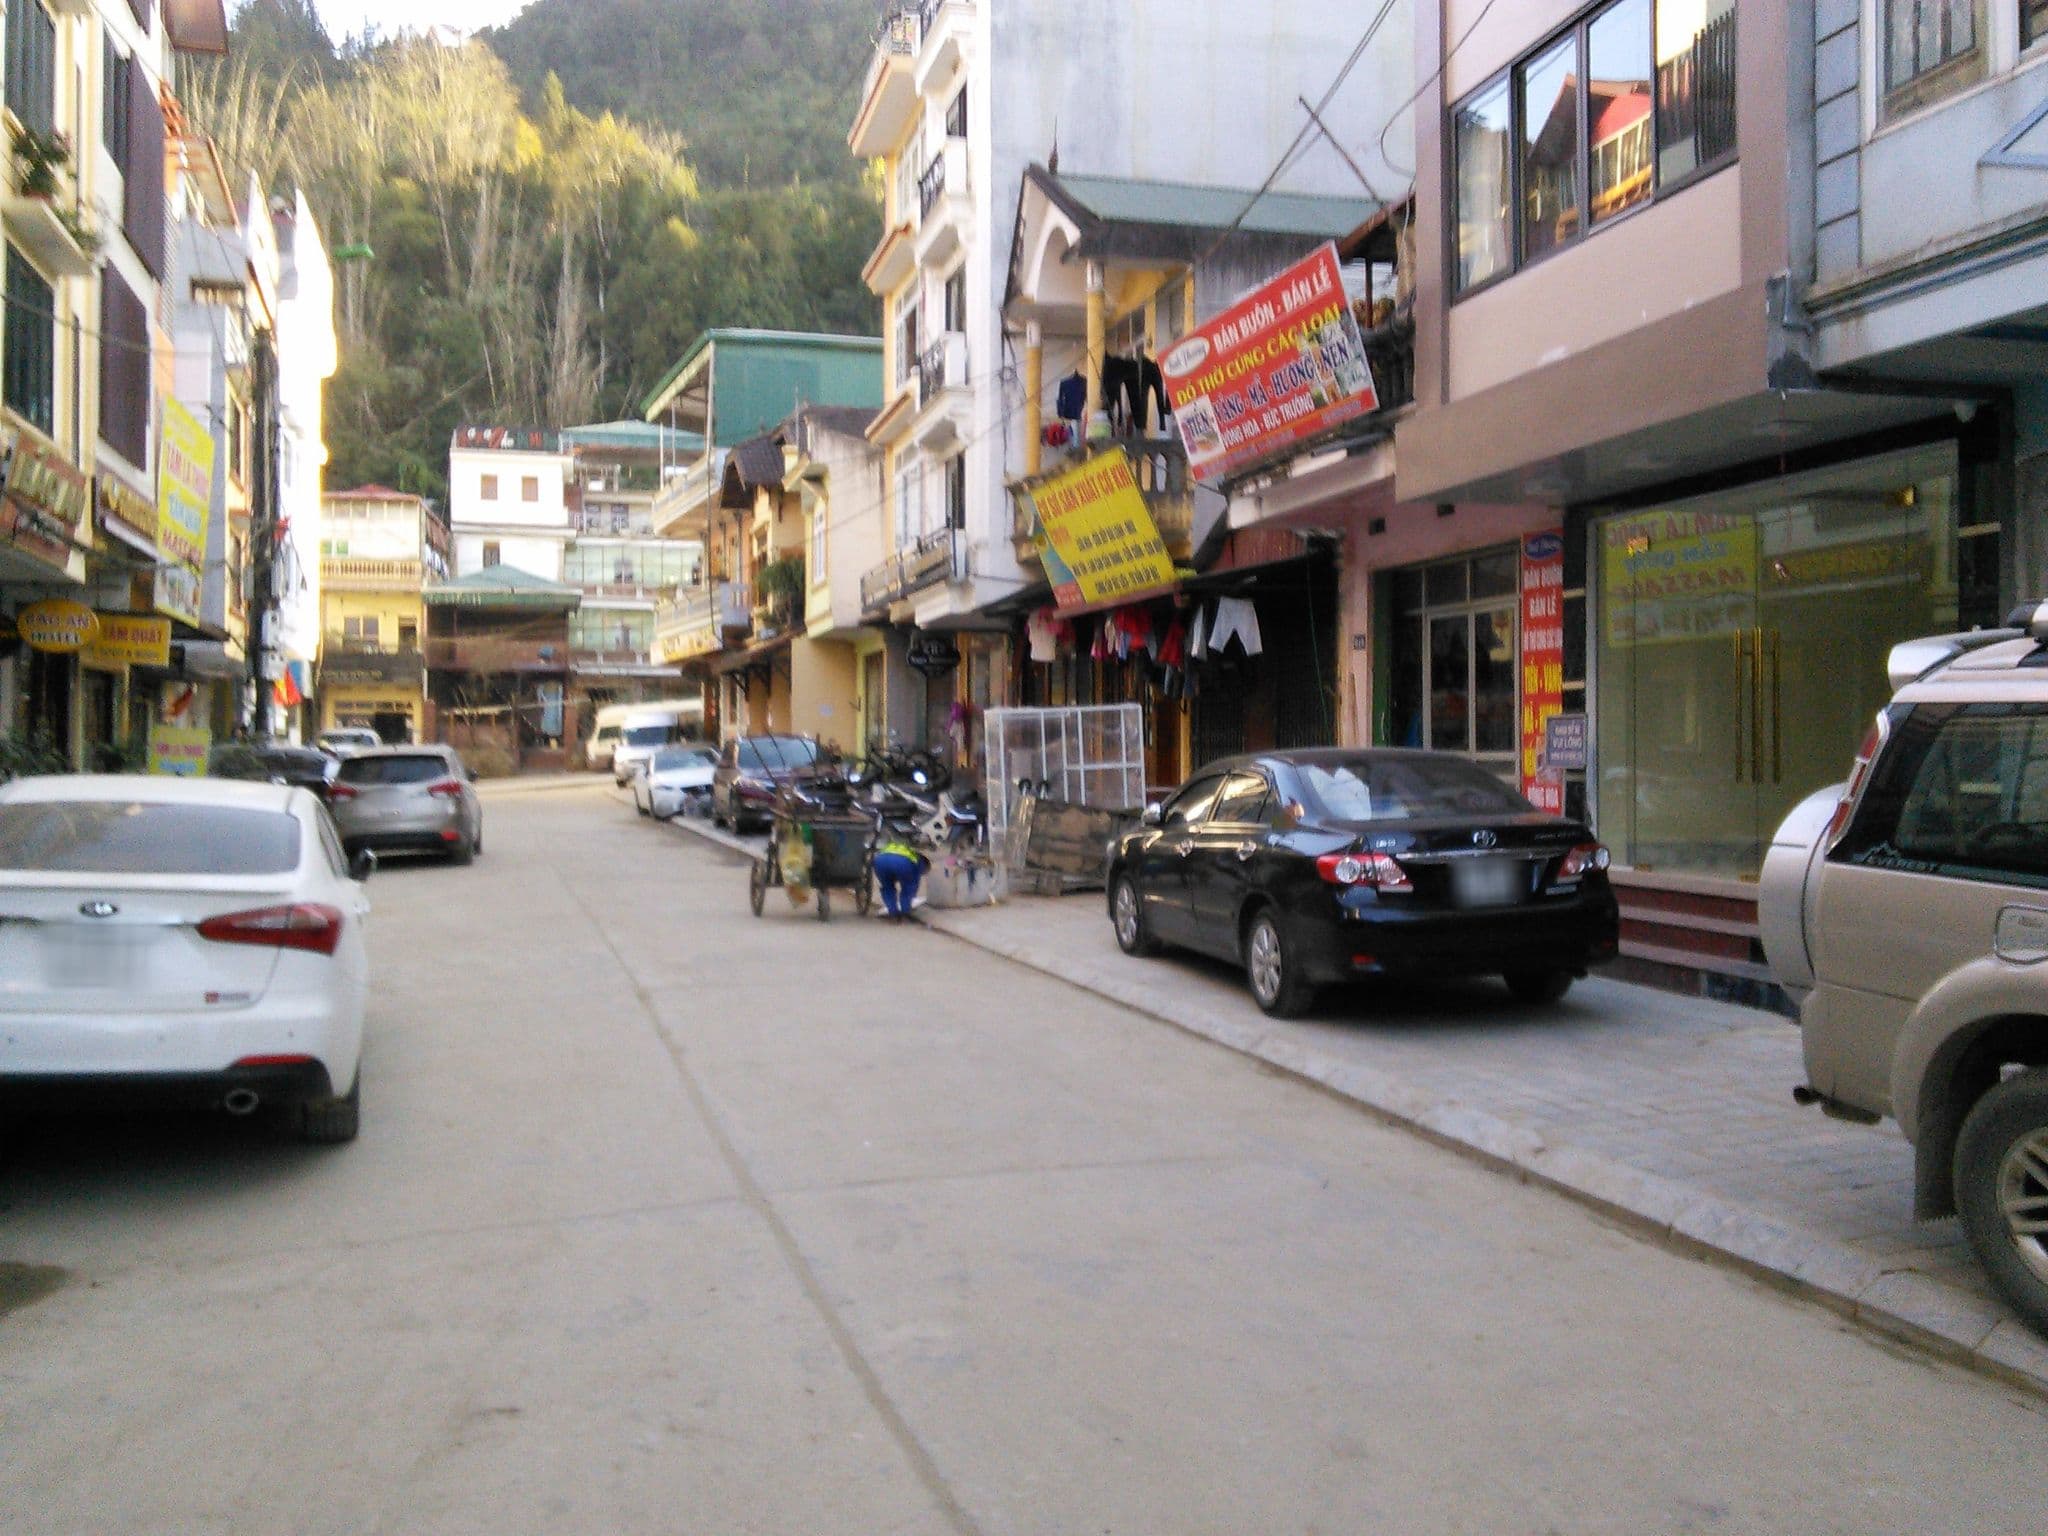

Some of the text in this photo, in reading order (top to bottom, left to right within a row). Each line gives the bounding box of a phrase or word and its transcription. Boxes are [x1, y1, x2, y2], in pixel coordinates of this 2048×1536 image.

[1213, 322, 1240, 354] BÁN
[1239, 301, 1275, 339] BUÔN
[1282, 277, 1312, 313] BÁN
[1226, 345, 1266, 378] CÚNG
[1242, 419, 1260, 438] HOA
